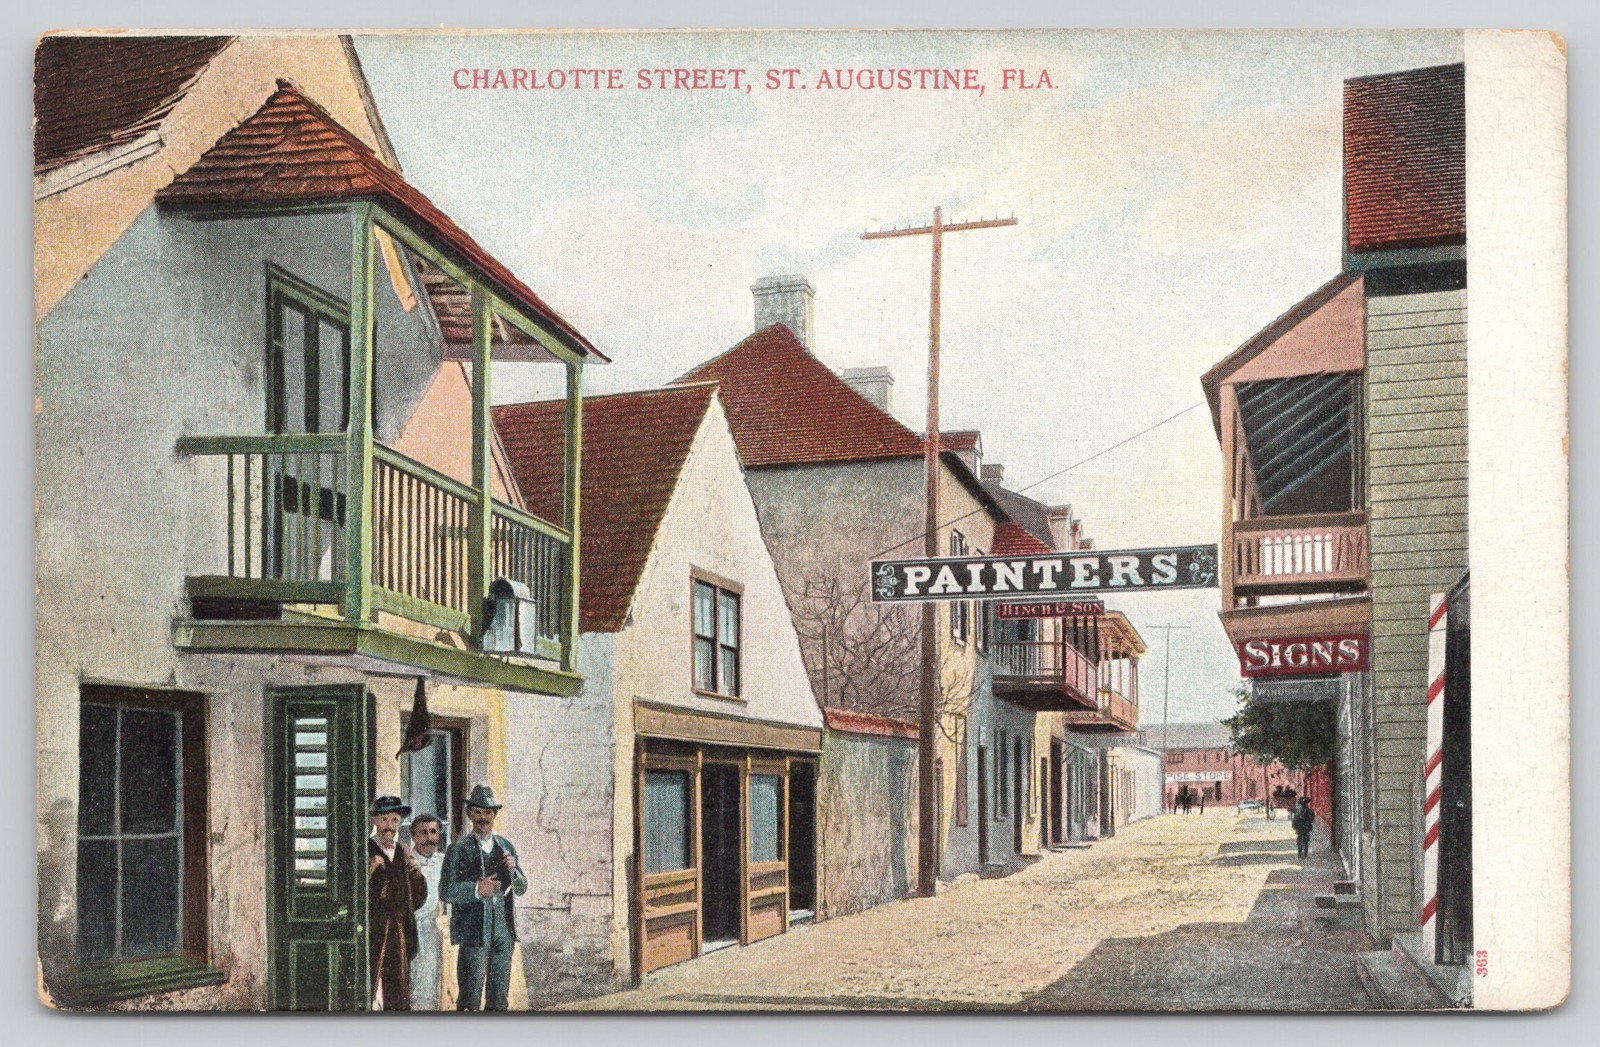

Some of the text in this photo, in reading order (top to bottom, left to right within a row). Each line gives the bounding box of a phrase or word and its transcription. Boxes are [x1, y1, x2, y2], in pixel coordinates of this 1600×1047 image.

[903, 552, 1178, 596] PAINTERS
[1071, 601, 1102, 613] SON
[1244, 639, 1360, 671] SIGNS
